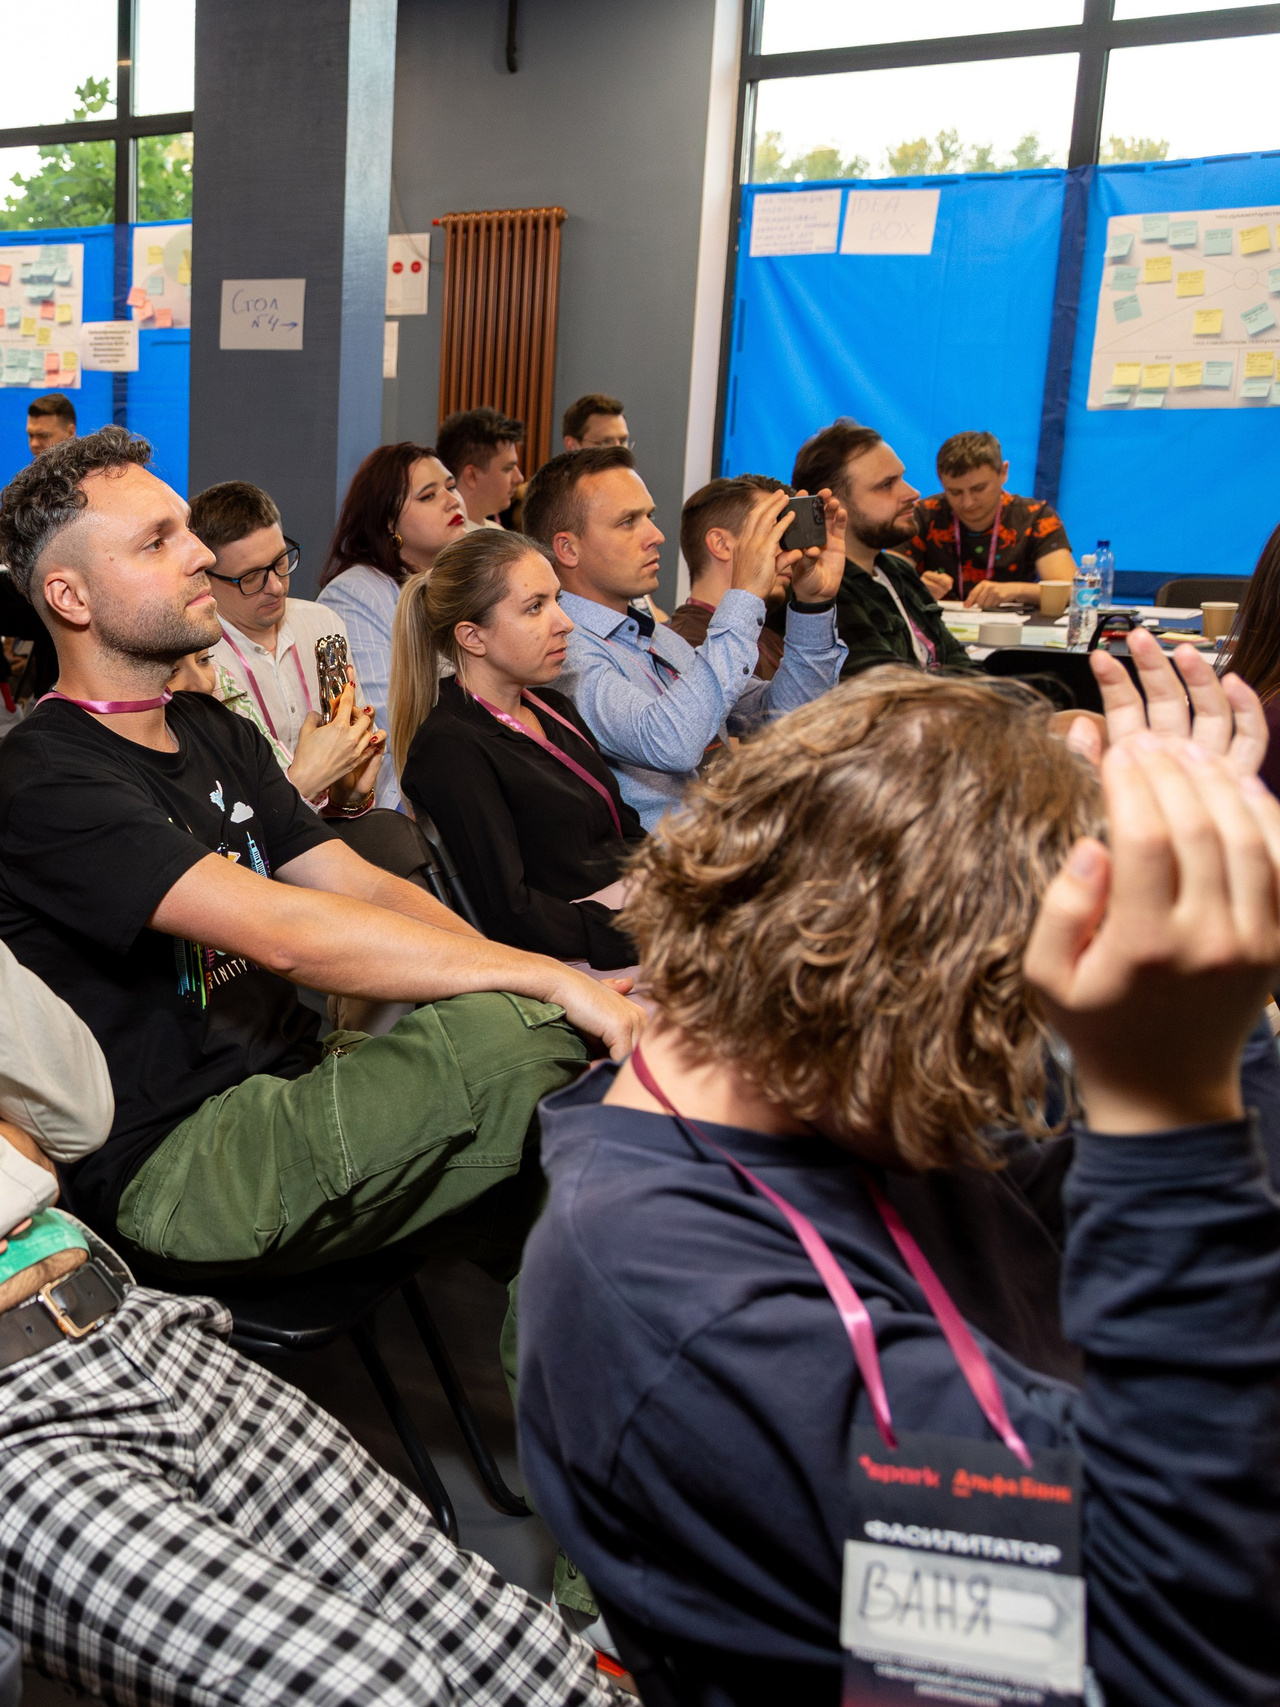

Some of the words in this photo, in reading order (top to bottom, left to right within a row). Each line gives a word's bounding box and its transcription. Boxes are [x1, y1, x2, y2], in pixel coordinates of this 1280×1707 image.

[868, 221, 916, 242] BOX
[863, 1519, 1062, 1566] ФАСИЛИТАТОР
[858, 1560, 992, 1636] ВАНЯ
